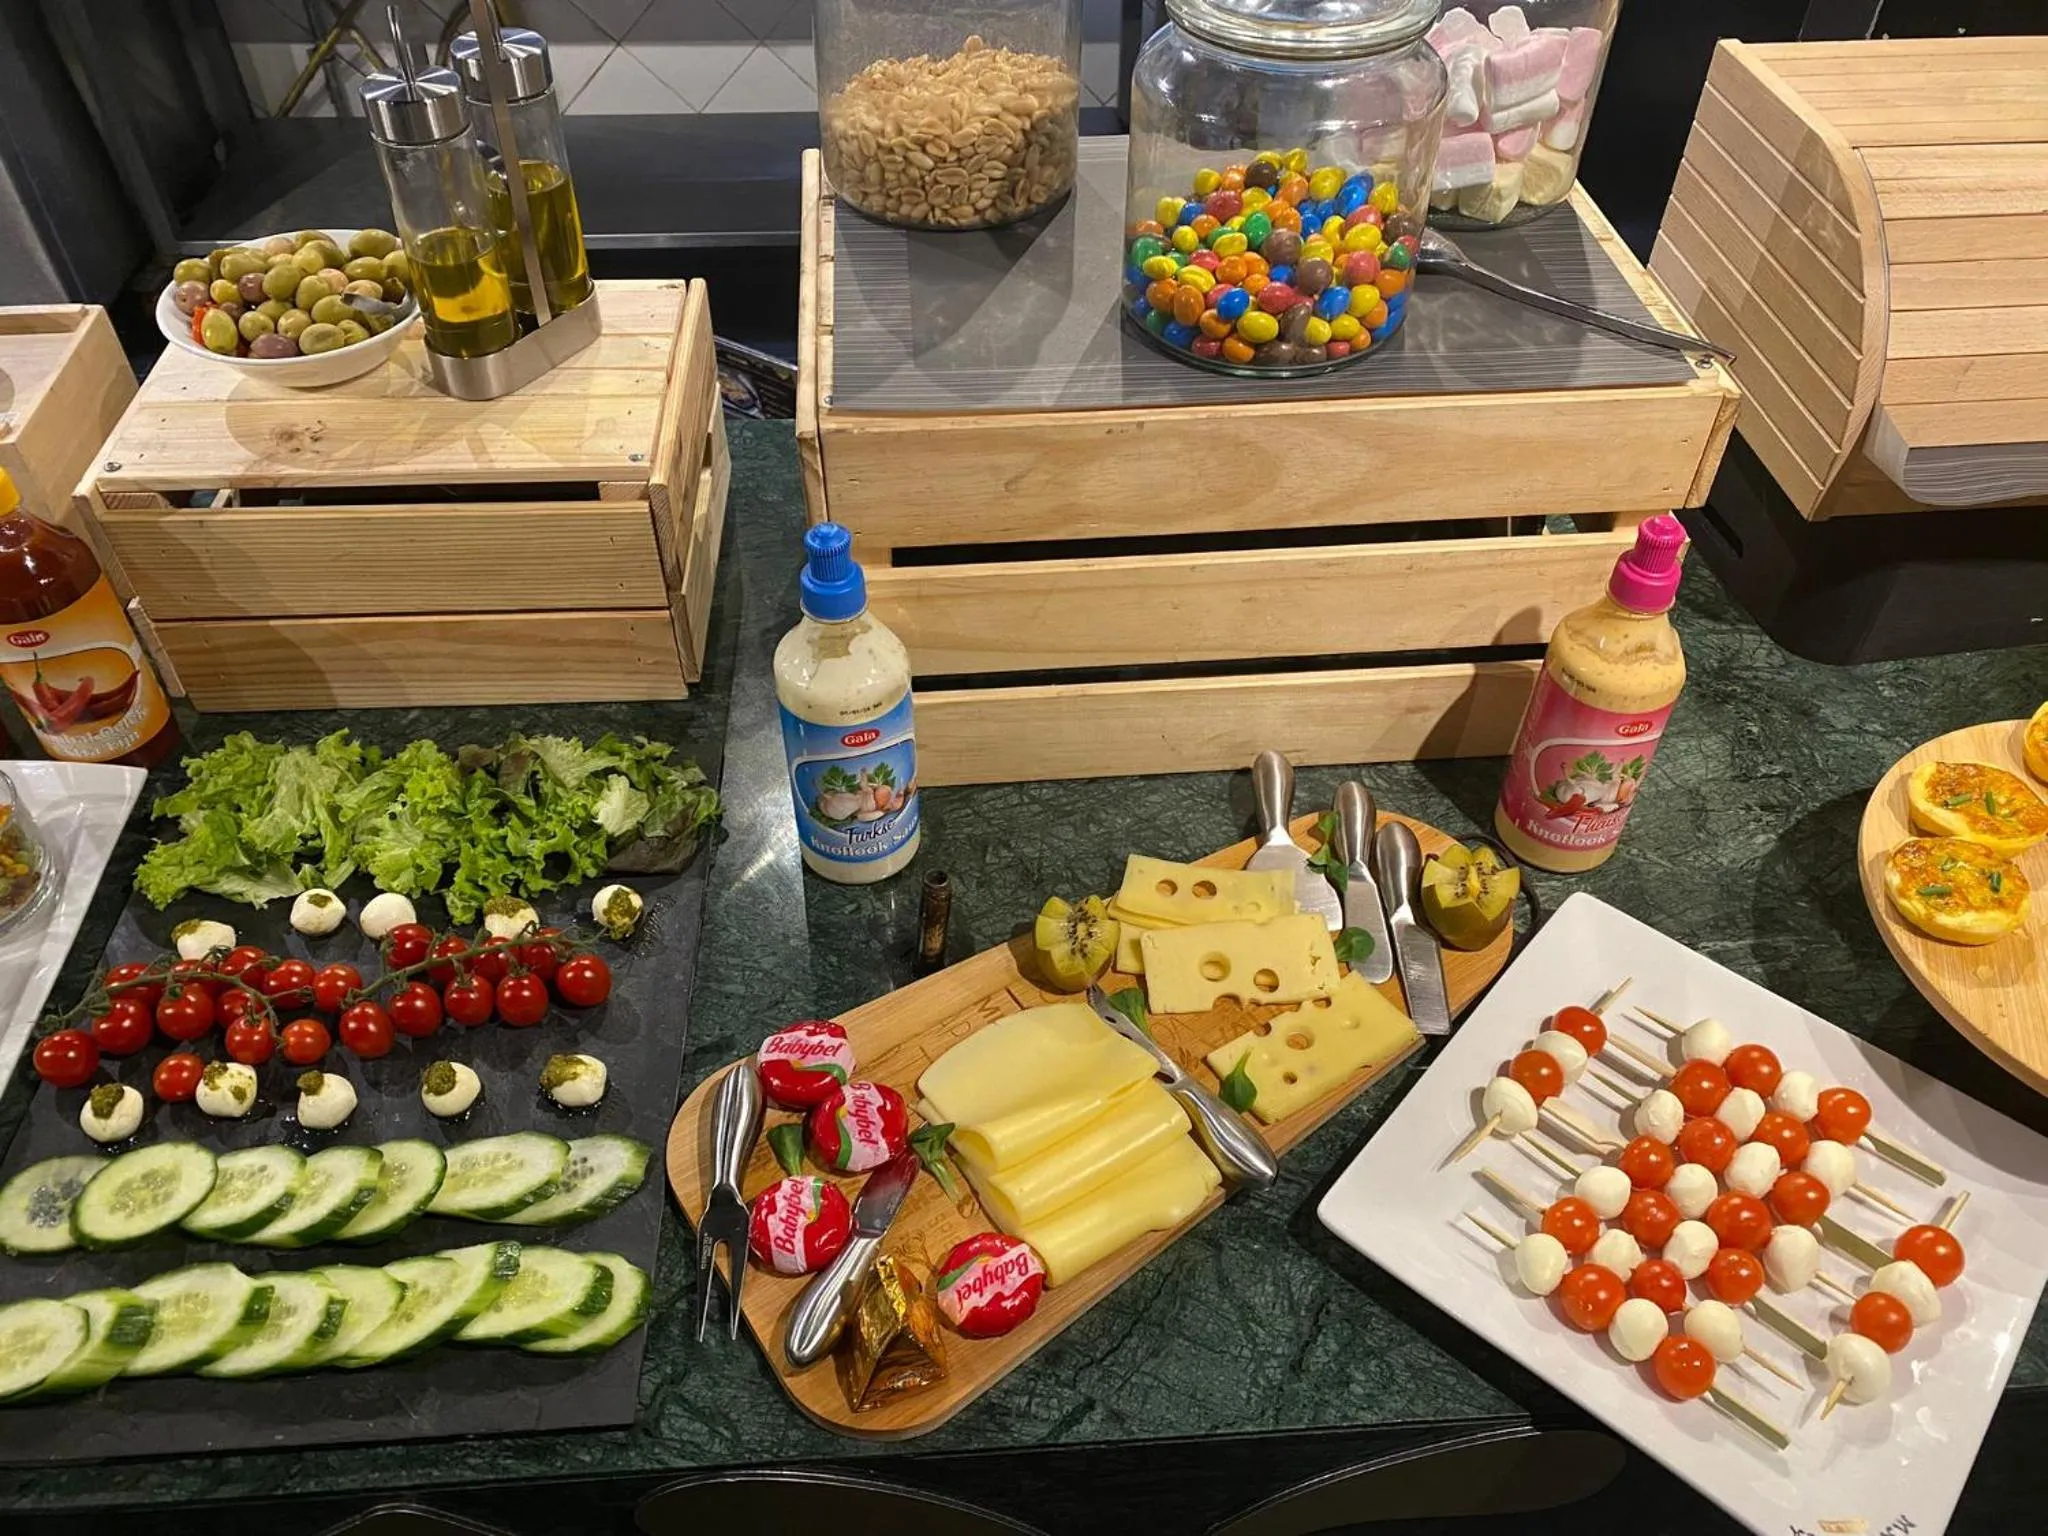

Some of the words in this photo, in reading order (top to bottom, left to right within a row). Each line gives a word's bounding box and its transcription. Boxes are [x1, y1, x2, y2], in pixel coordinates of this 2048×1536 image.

[844, 819, 896, 845] Turkse
[1527, 819, 1606, 846] Knoflook
[765, 1036, 844, 1060] Babybel
[850, 1081, 878, 1147] Babybel
[773, 1179, 805, 1255] Babybel
[955, 1252, 1029, 1312] Babybel
